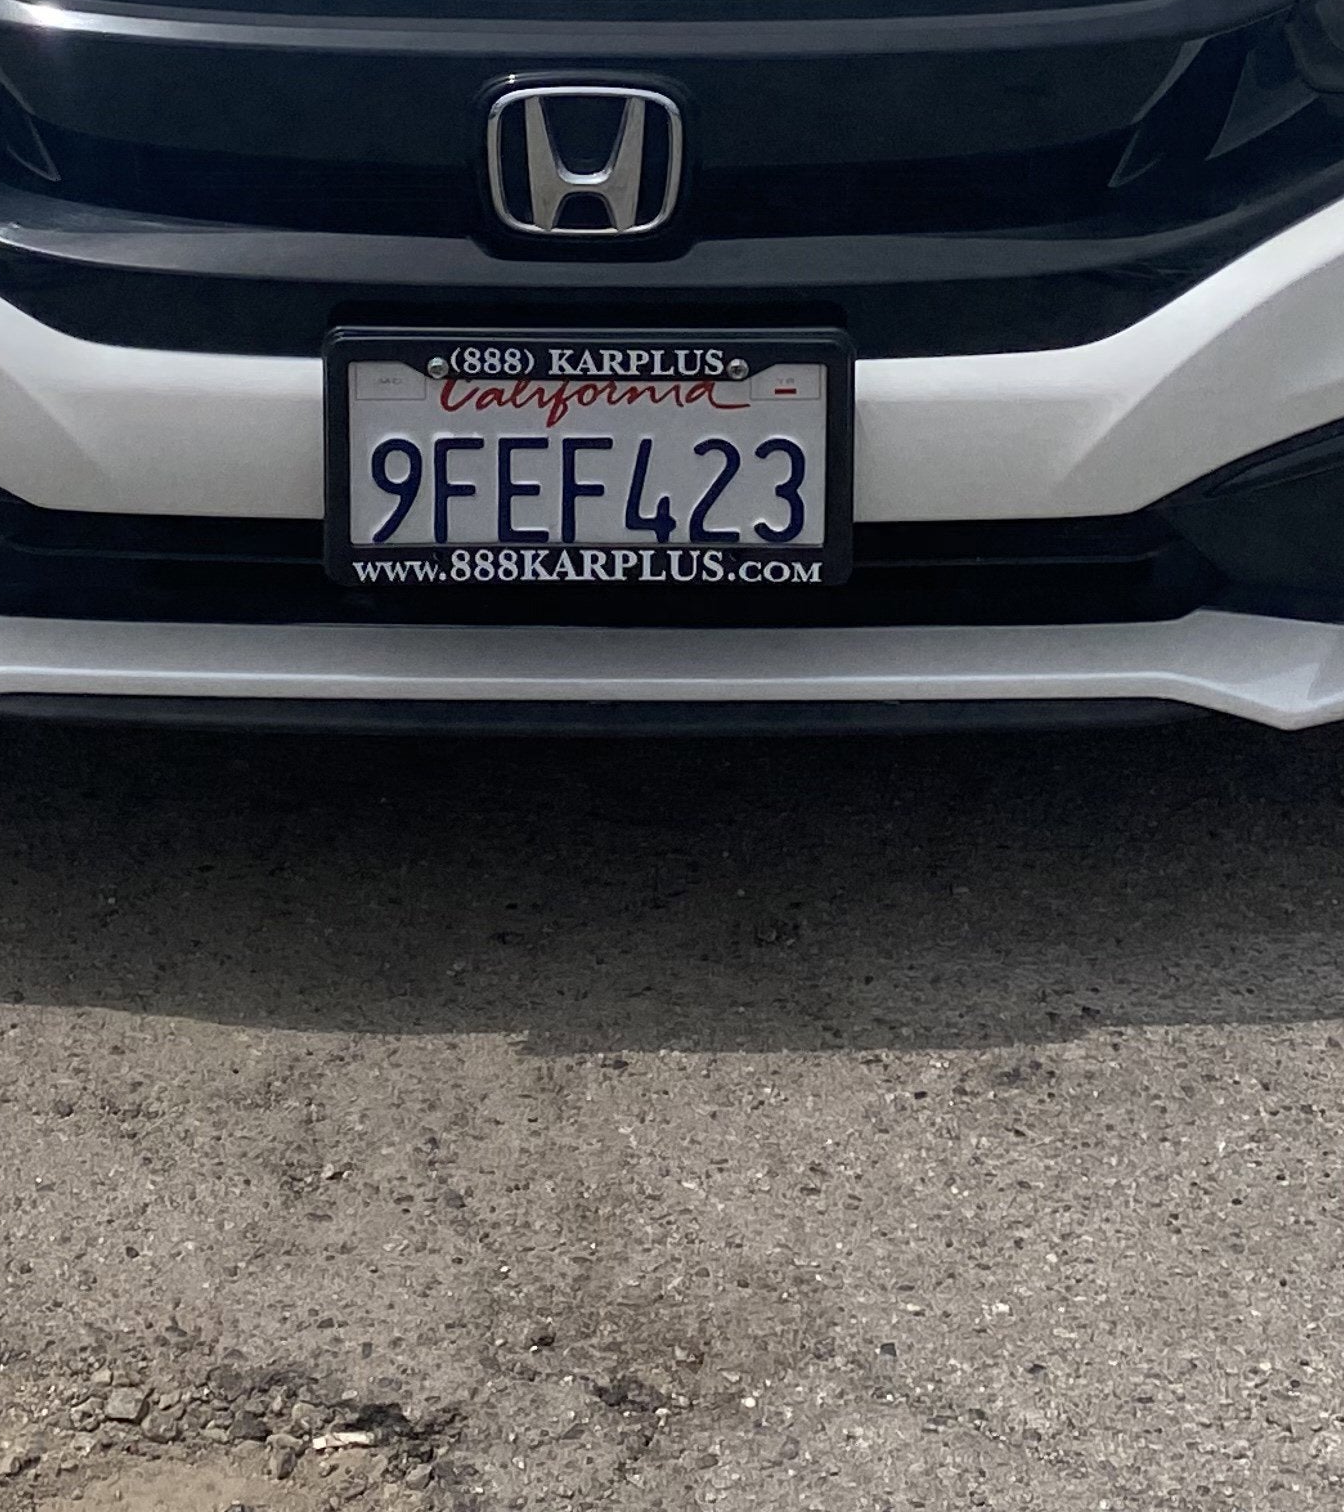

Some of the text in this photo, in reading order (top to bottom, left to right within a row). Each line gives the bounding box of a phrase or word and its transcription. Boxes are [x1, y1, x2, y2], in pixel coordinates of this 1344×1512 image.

[450, 346, 725, 377] (888) KARPLUS
[440, 378, 751, 429] California
[370, 437, 806, 544] 9FEF423
